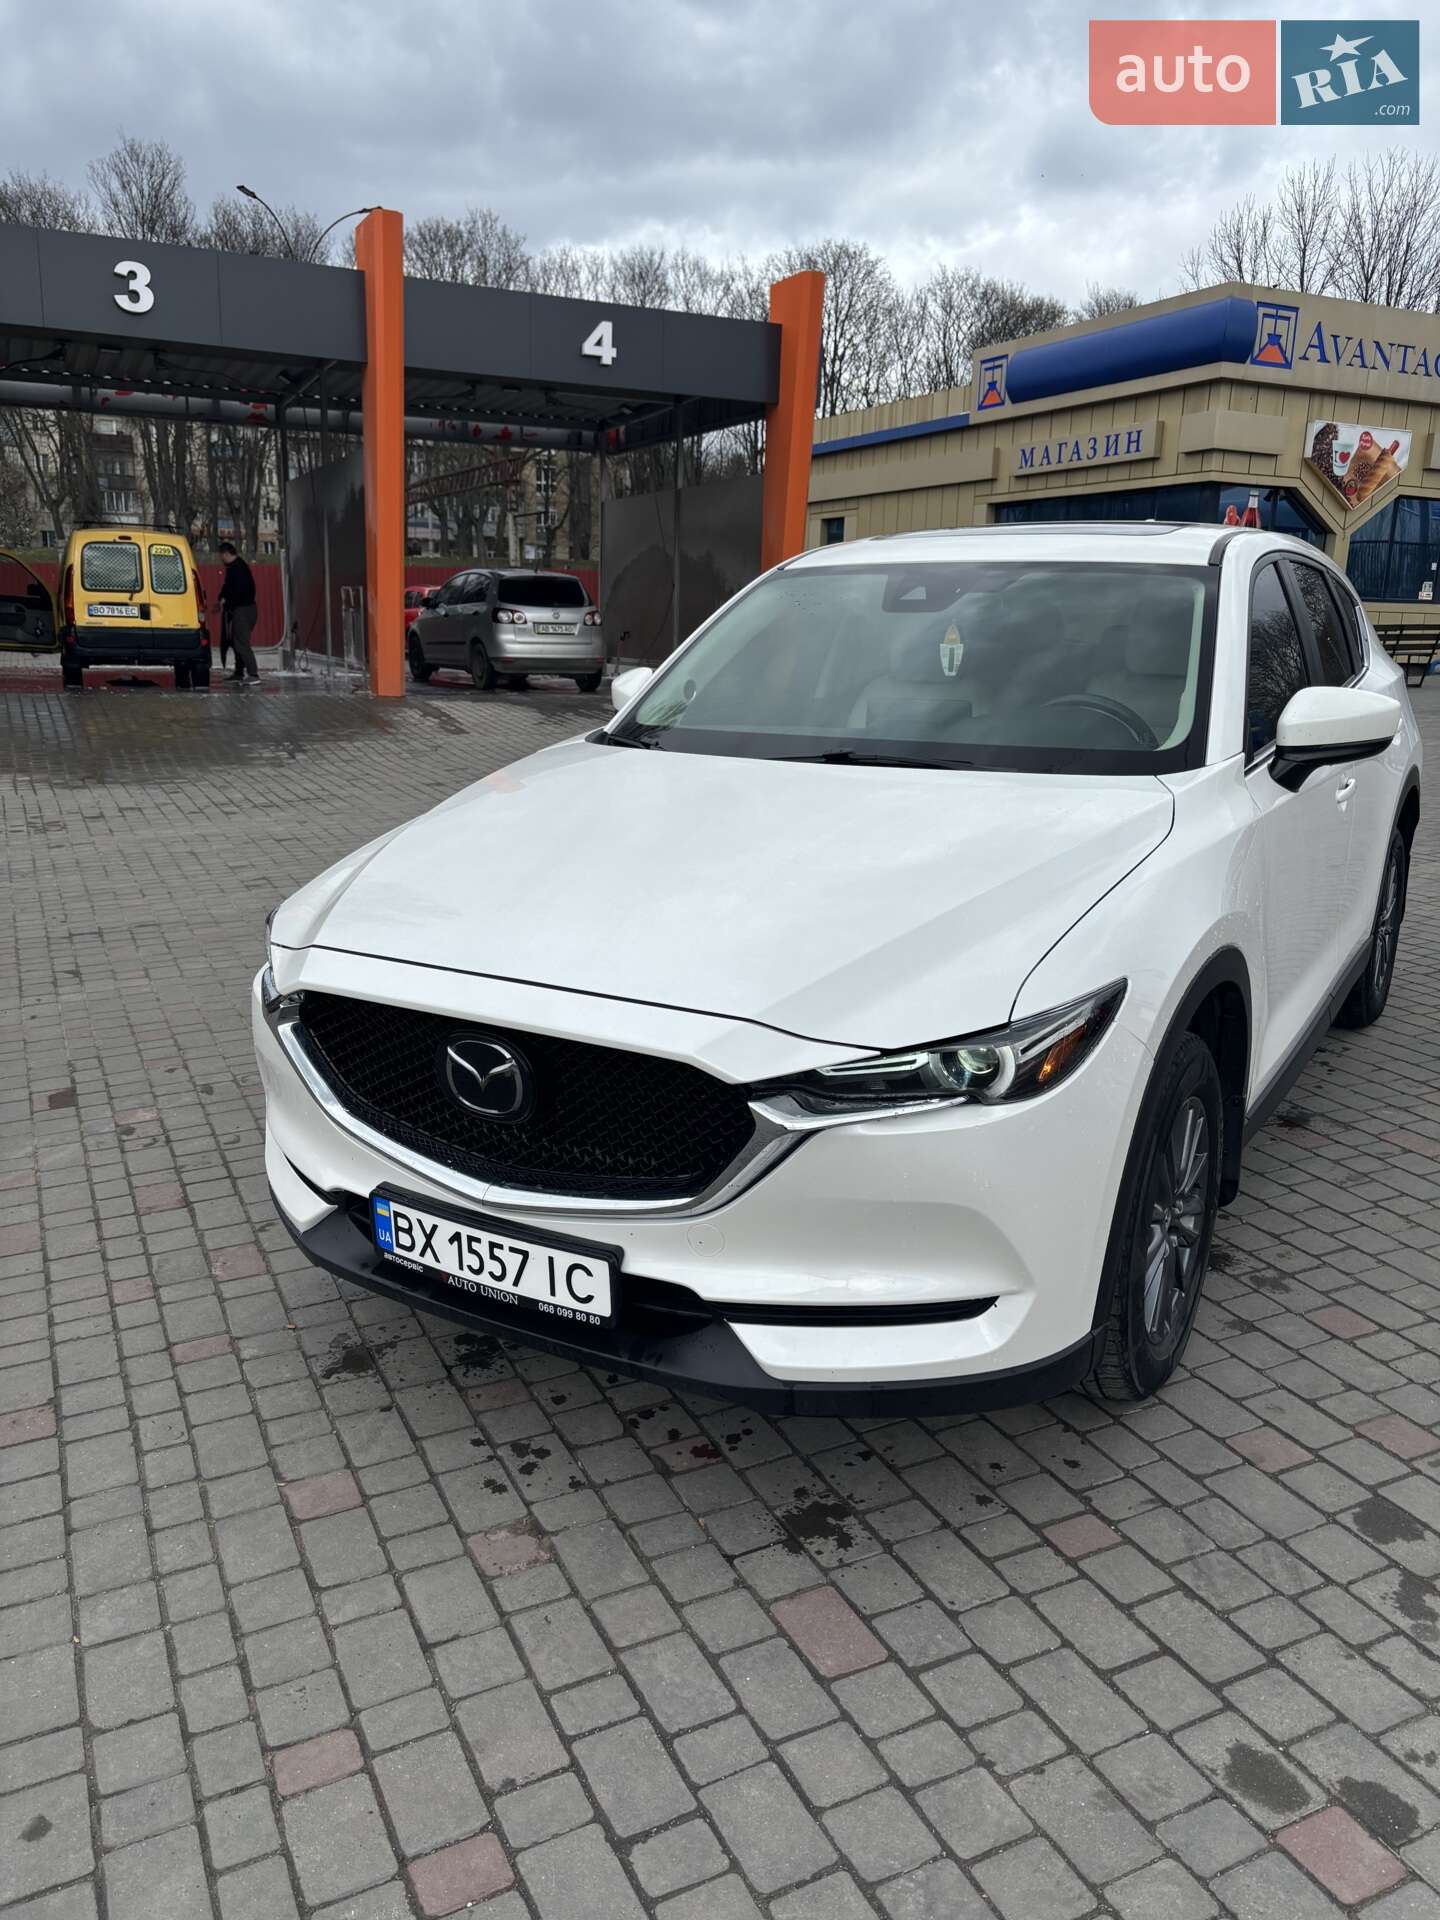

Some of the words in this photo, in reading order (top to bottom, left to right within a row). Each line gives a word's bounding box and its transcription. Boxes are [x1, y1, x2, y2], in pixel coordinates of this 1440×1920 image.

[113, 260, 154, 313] 3
[581, 320, 617, 366] 4
[1018, 429, 1143, 470] МАГАЗИН
[378, 1230, 392, 1243] UA
[383, 1252, 424, 1273] автосервіс
[393, 1209, 440, 1264] BX
[447, 1231, 530, 1287] 1557
[548, 1255, 595, 1304] IC
[447, 1275, 477, 1293] AUTO
[480, 1284, 519, 1305] UNION
[538, 1302, 555, 1314] 068
[557, 1306, 573, 1319] 099
[575, 1311, 587, 1322] 80
[589, 1314, 601, 1326] 80
